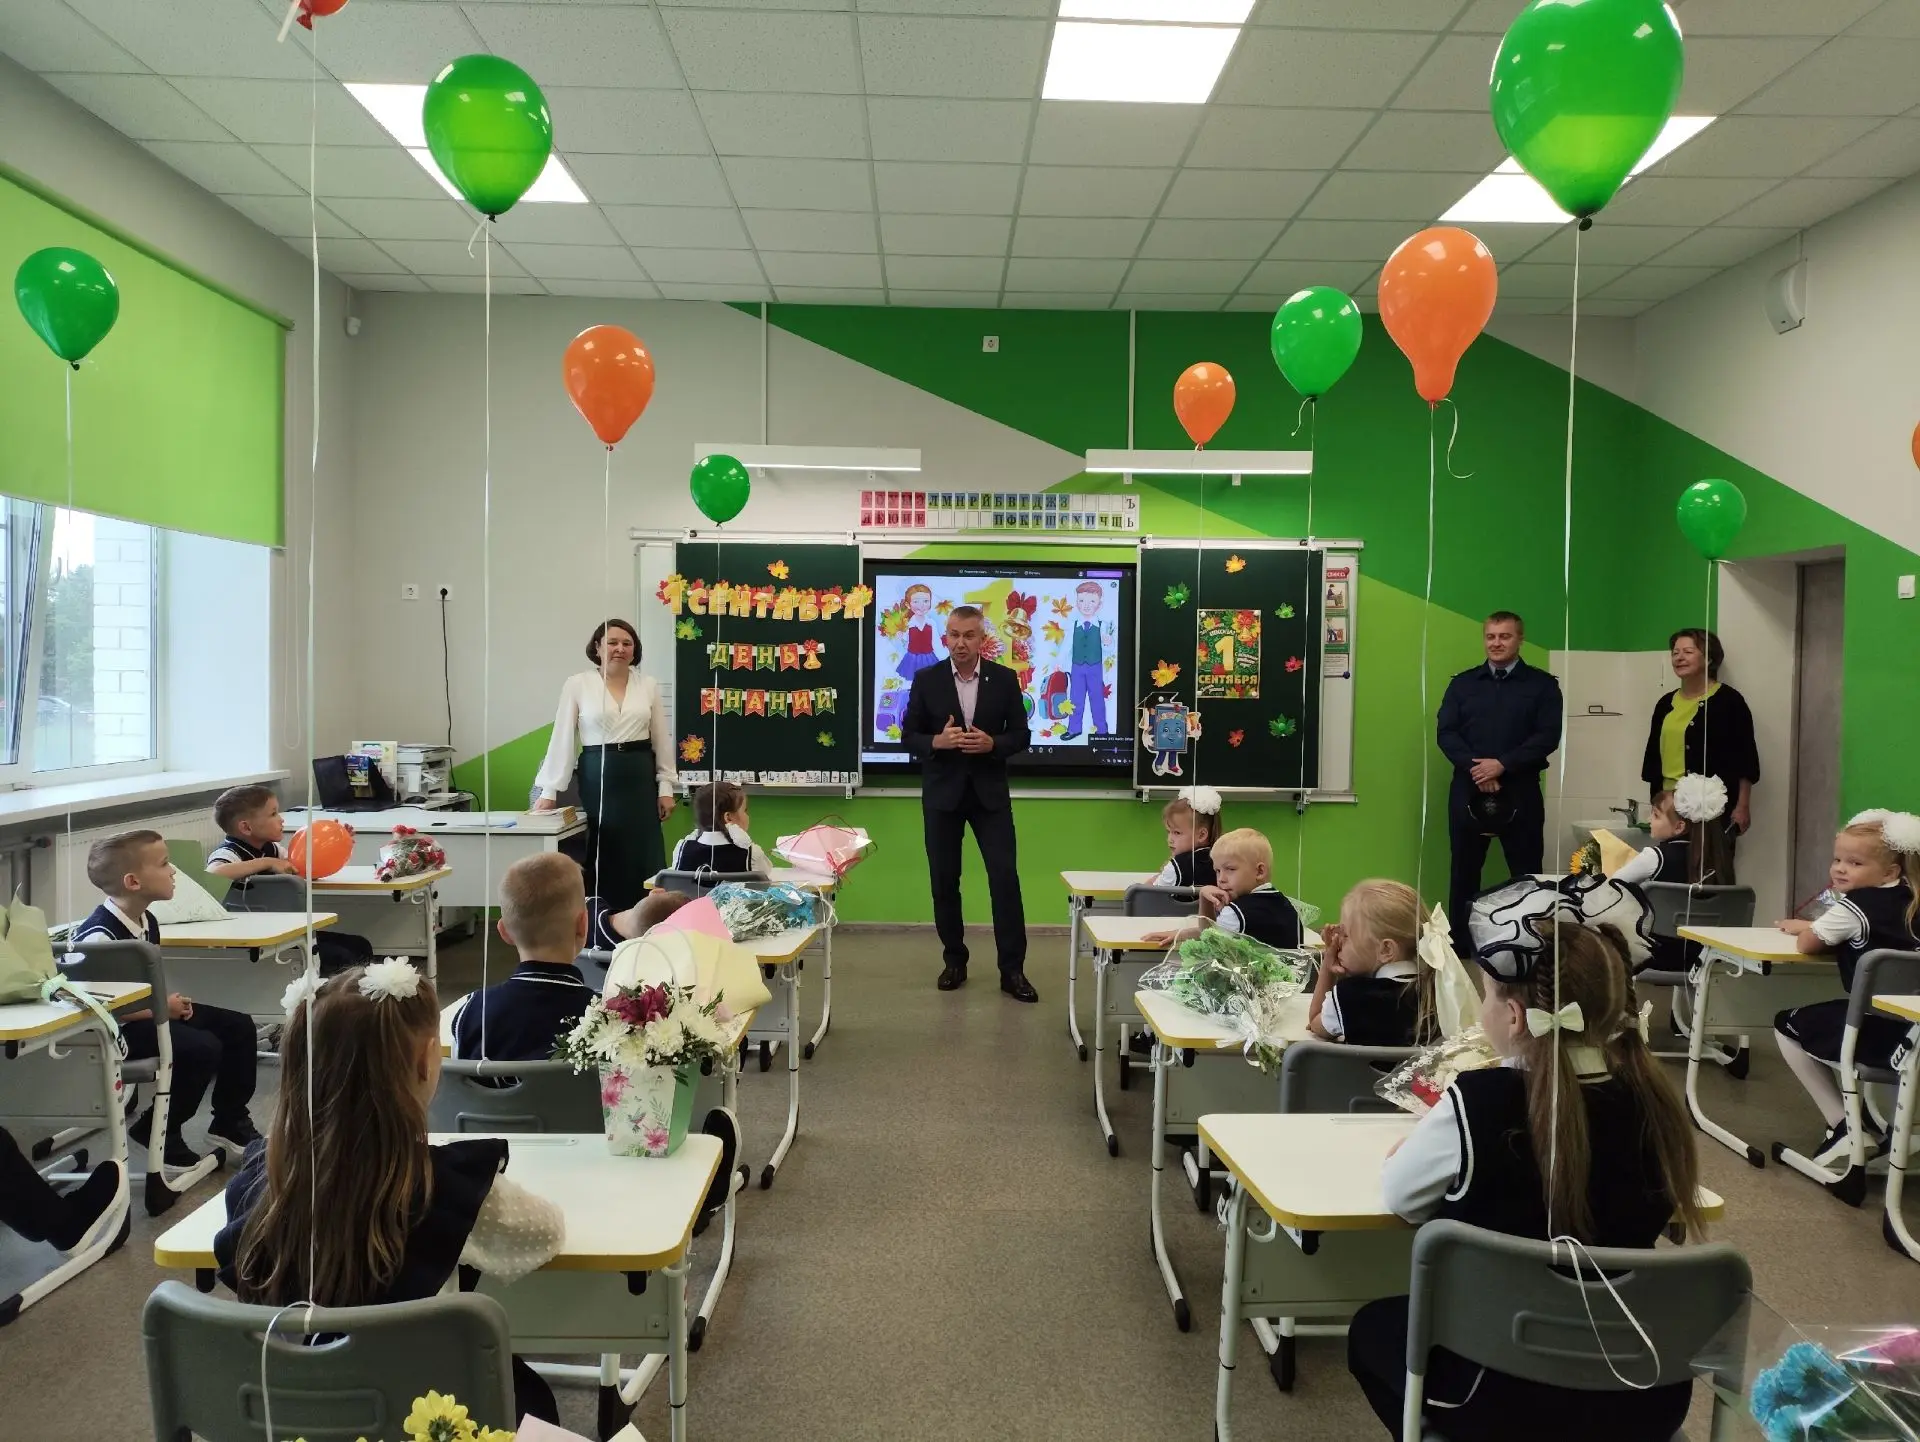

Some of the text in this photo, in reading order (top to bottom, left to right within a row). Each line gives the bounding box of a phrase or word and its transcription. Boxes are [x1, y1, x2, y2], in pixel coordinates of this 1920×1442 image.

[928, 495, 938, 506] Л
[941, 495, 952, 506] М
[970, 495, 978, 506] Р
[982, 493, 991, 507] Й
[995, 496, 1003, 507] Б
[1007, 496, 1016, 507] В
[1021, 496, 1028, 507] Г
[1033, 497, 1042, 510] Д
[1046, 496, 1056, 507] Ж
[1060, 496, 1067, 507] З
[1126, 498, 1136, 509] Ъ
[887, 512, 899, 524] Ю
[994, 515, 1004, 526] П
[1007, 515, 1016, 526] Ф
[1020, 515, 1028, 526] К
[1033, 515, 1042, 526] Т
[1060, 515, 1068, 526] С
[1072, 515, 1081, 526] Х
[1100, 516, 1108, 526] Ч
[1112, 516, 1122, 528] Щ
[1127, 517, 1134, 528] Ь
[664, 581, 865, 622] 1 СЕНТЯБРЯ
[711, 643, 798, 665] ДЕНЬ
[1214, 635, 1235, 671] 1
[1198, 674, 1258, 685] СЕНТЯБРЯ
[702, 687, 833, 710] ЗНАНИЙ
